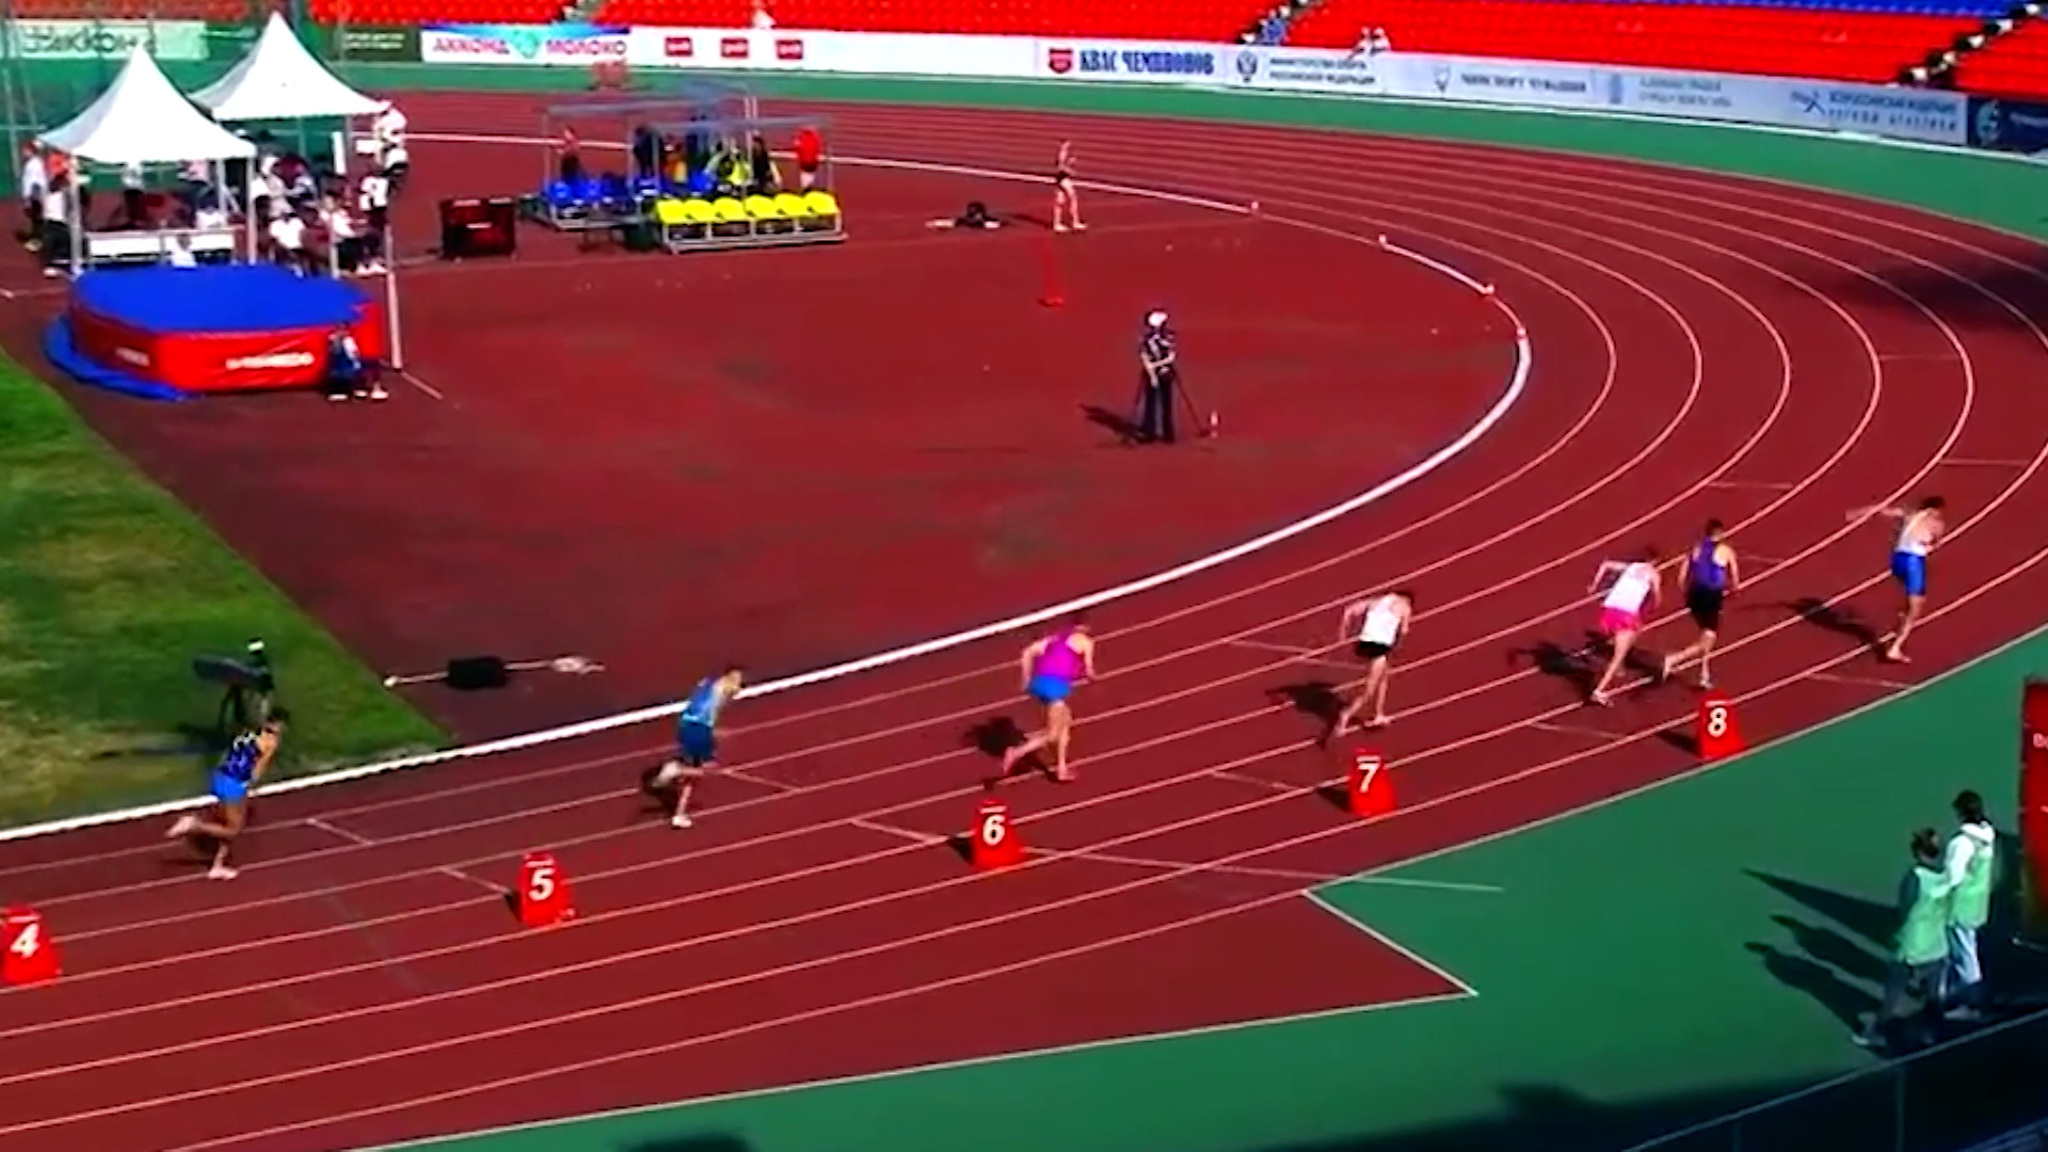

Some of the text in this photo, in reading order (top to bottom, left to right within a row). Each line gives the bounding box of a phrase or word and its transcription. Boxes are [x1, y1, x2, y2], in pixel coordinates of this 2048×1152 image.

[546, 39, 627, 55] МОЛОКО
[1708, 707, 1727, 737] 8
[1357, 762, 1379, 792] 7
[982, 814, 1005, 845] 6
[529, 868, 554, 901] 5
[10, 923, 39, 957] 4
